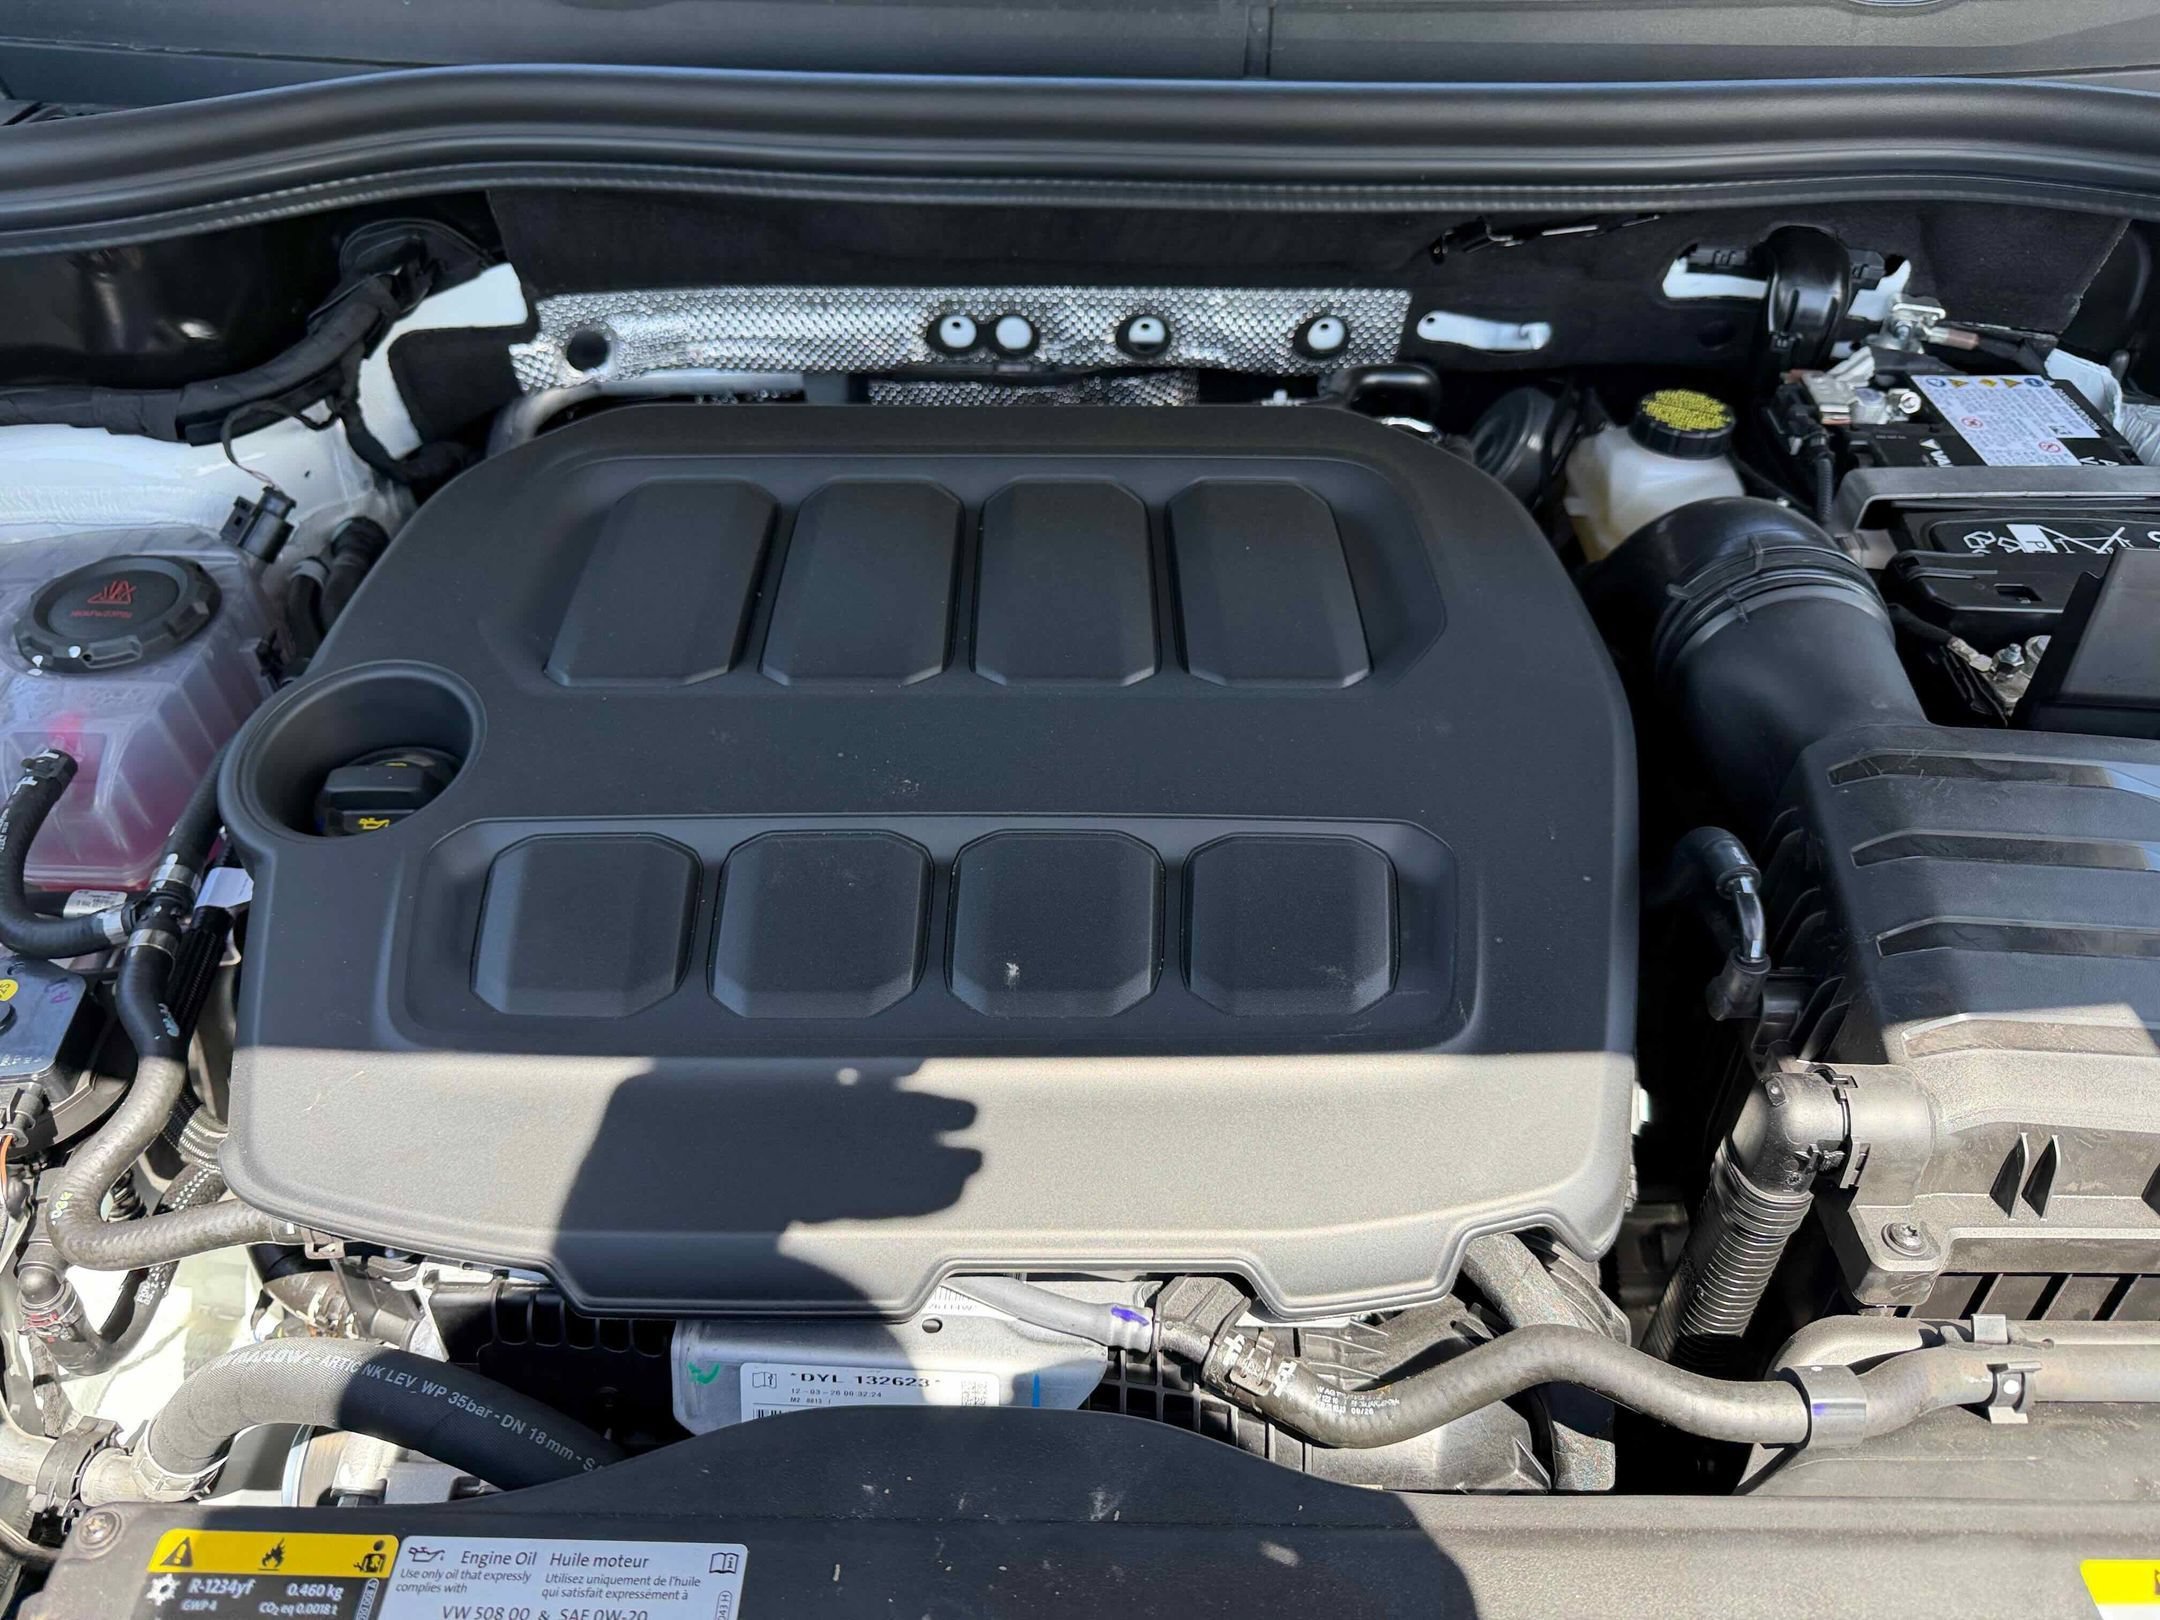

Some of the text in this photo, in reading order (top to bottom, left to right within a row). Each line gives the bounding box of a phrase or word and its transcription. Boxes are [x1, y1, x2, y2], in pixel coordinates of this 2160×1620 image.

[362, 1364, 386, 1379] NK
[460, 1550, 538, 1569] Engine Oil
[549, 1552, 650, 1568] Huile moteur
[400, 1567, 532, 1584] Use only oil that expressly
[545, 1573, 702, 1587] Utilisez uniquement de l'huile
[187, 1577, 345, 1602] R-1234yf 0.460 kg
[395, 1582, 468, 1595] complies with
[541, 1588, 560, 1600] qui
[560, 1587, 603, 1599] satisfait
[678, 1590, 689, 1600] à
[180, 1599, 218, 1612] GWP 4
[280, 1604, 295, 1617] eq
[295, 1602, 332, 1616] 0.0018
[331, 1604, 339, 1616] t
[442, 1605, 472, 1620] VW
[474, 1606, 505, 1620] 508
[508, 1607, 531, 1620] 00
[537, 1609, 551, 1620] &
[558, 1608, 591, 1620] SAE
